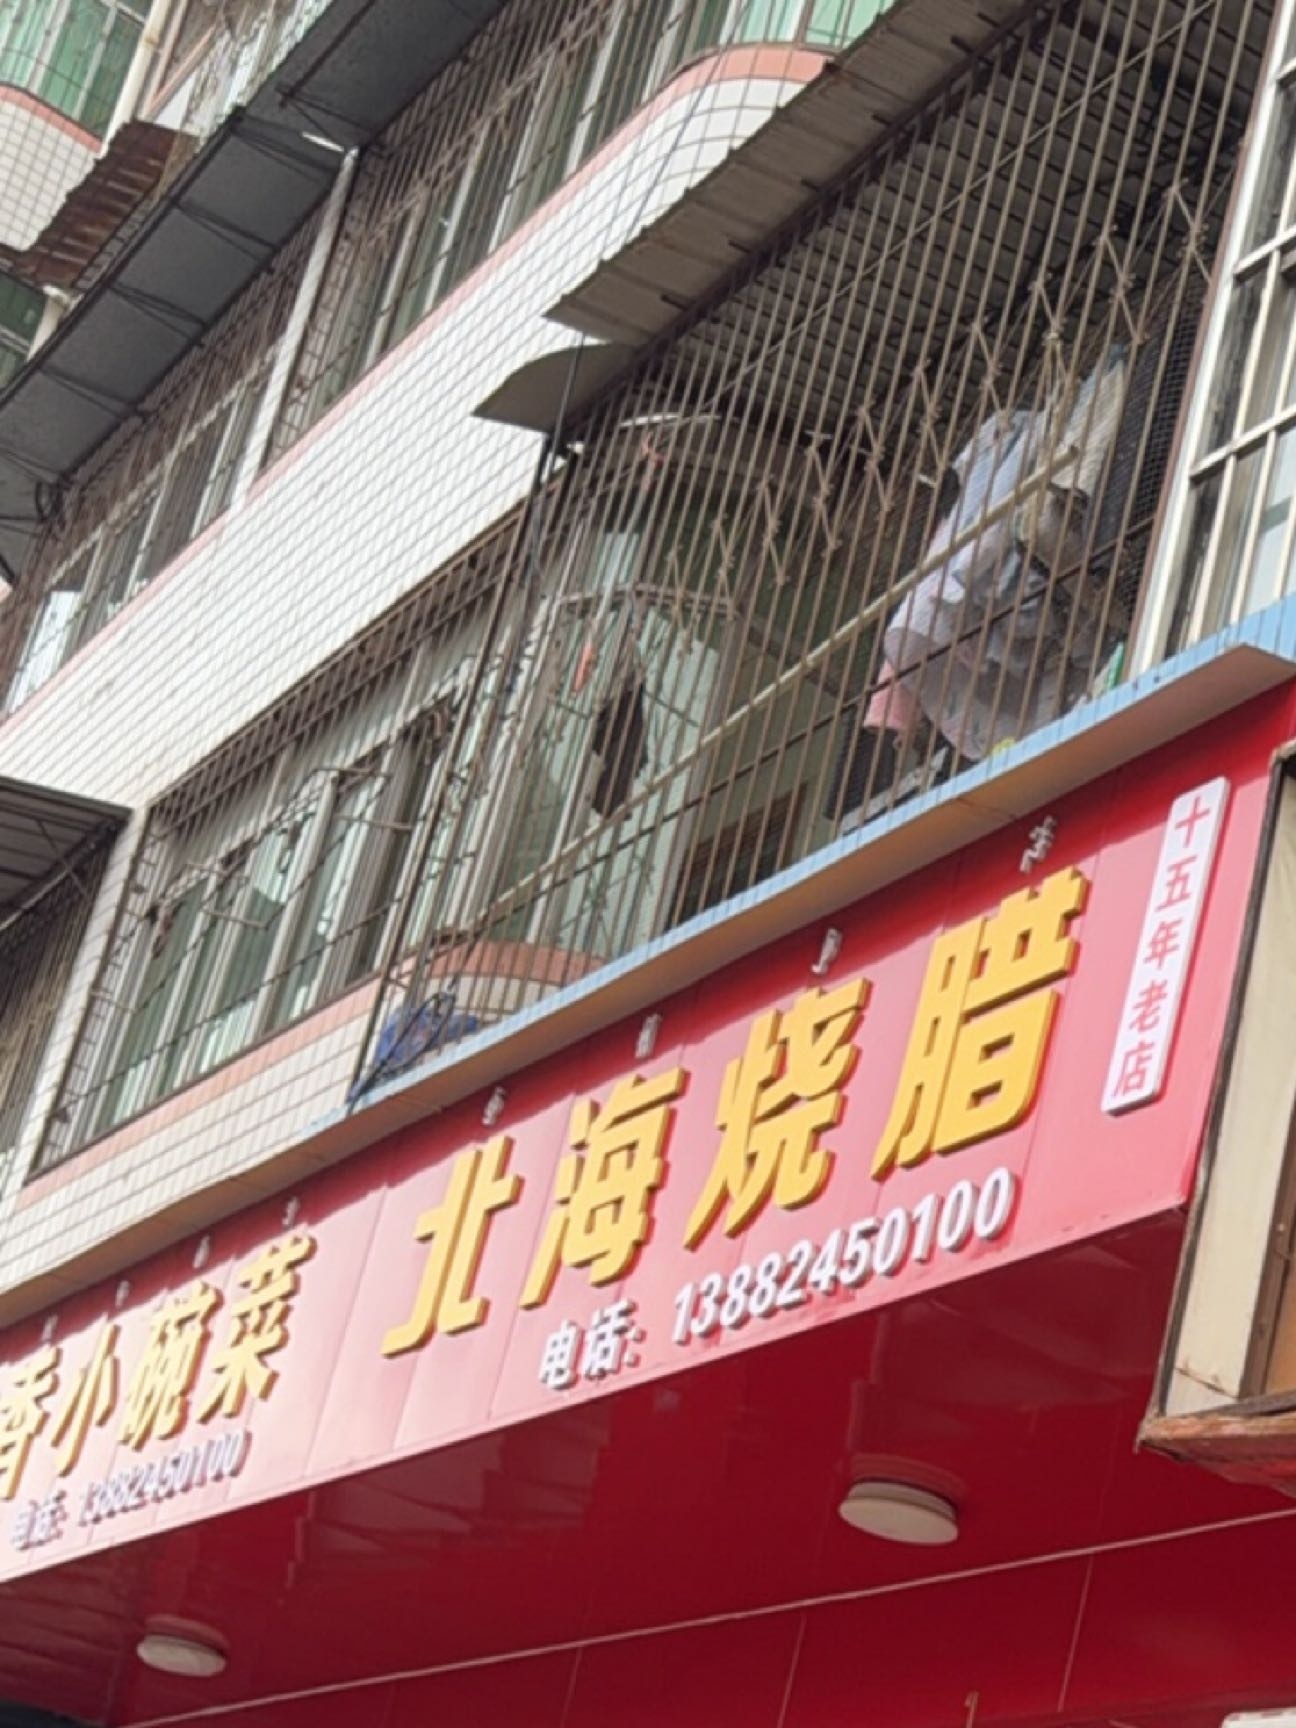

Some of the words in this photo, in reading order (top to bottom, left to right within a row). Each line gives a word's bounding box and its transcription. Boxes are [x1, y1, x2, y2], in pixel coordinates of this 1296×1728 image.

[1112, 794, 1212, 1098] 十五年老店
[380, 864, 1089, 1359] 北海烧腊
[671, 1165, 1017, 1345] 13882450100
